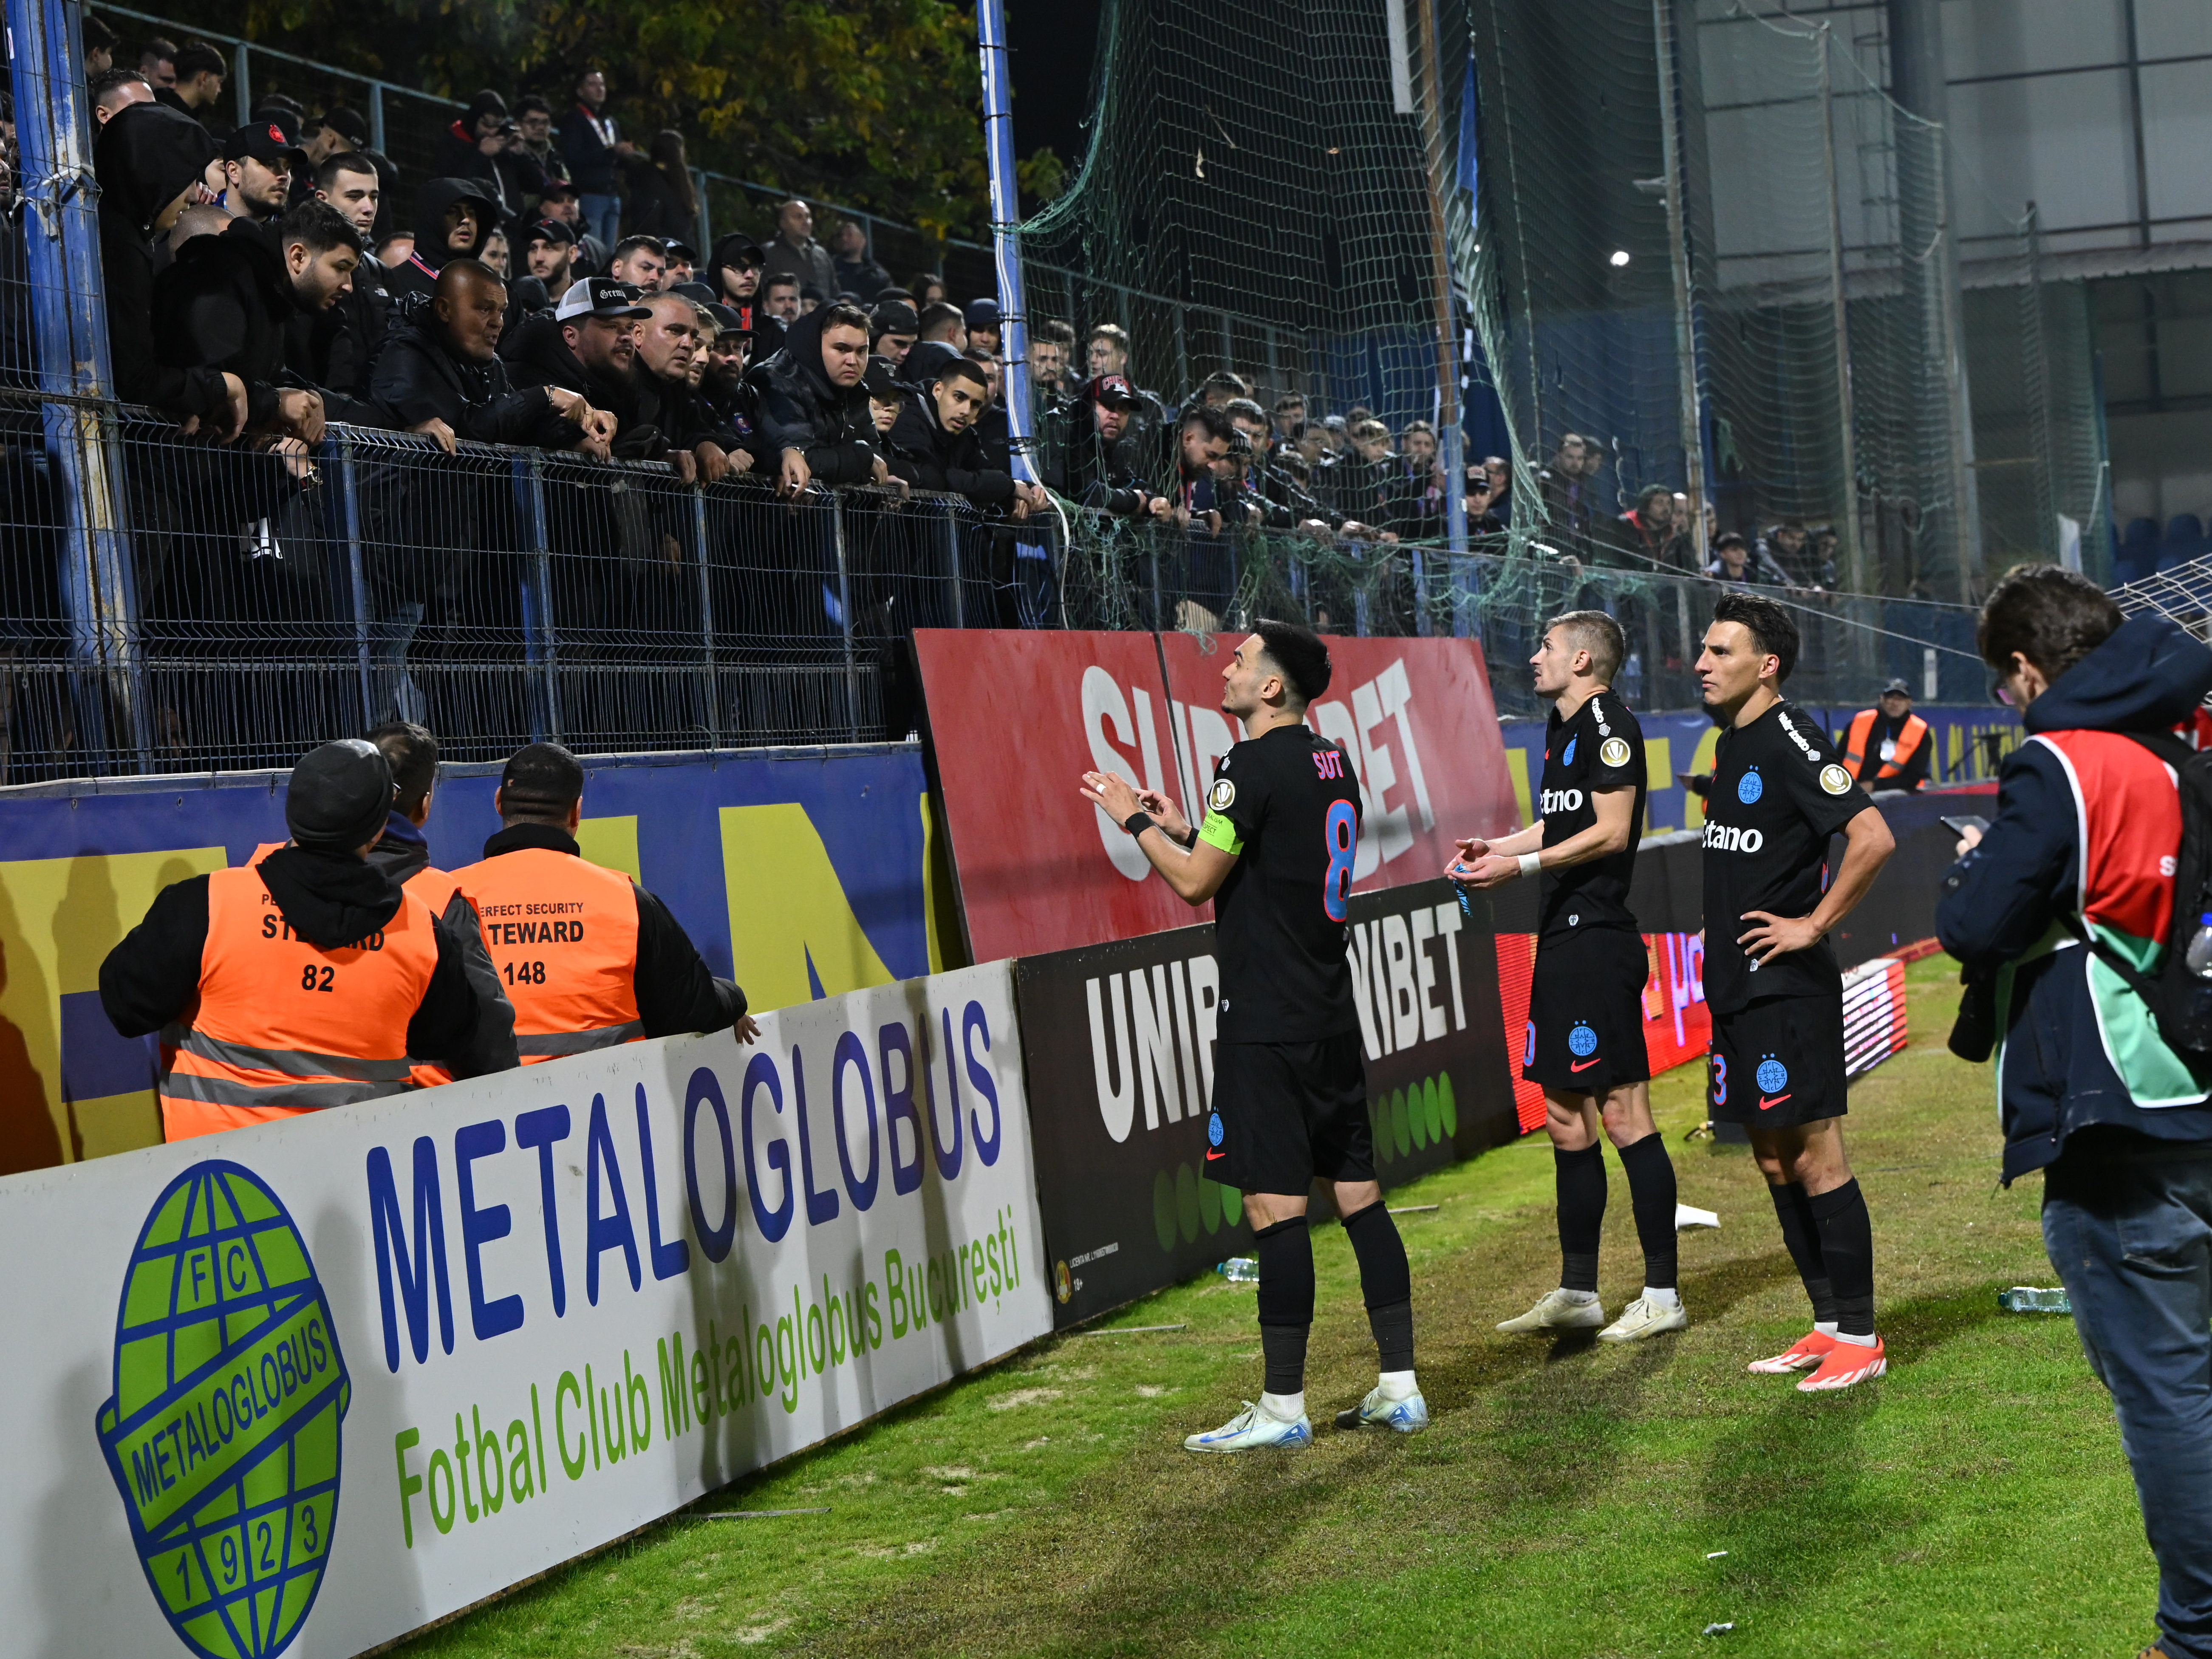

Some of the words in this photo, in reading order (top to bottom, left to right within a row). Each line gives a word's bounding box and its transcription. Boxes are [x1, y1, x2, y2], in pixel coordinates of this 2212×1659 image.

[1312, 750, 1344, 780] SUT
[1324, 799, 1357, 922] 8
[484, 921, 584, 945] TEWARD
[526, 902, 583, 915] SECURITY
[302, 964, 335, 992] 82
[504, 961, 546, 986] 148
[1086, 954, 1219, 1143] UNIB
[1345, 901, 1466, 1061] NIBET
[1713, 1054, 1726, 1105] 3
[366, 1000, 1001, 1374] METALOGLOBUS
[132, 1320, 327, 1507] METALOGLOBUS
[395, 1382, 548, 1549] Fotbal
[555, 1349, 651, 1481] Club
[656, 1272, 882, 1441] Metaloglobus
[885, 1204, 1021, 1340] București
[176, 1505, 318, 1602] 1923
